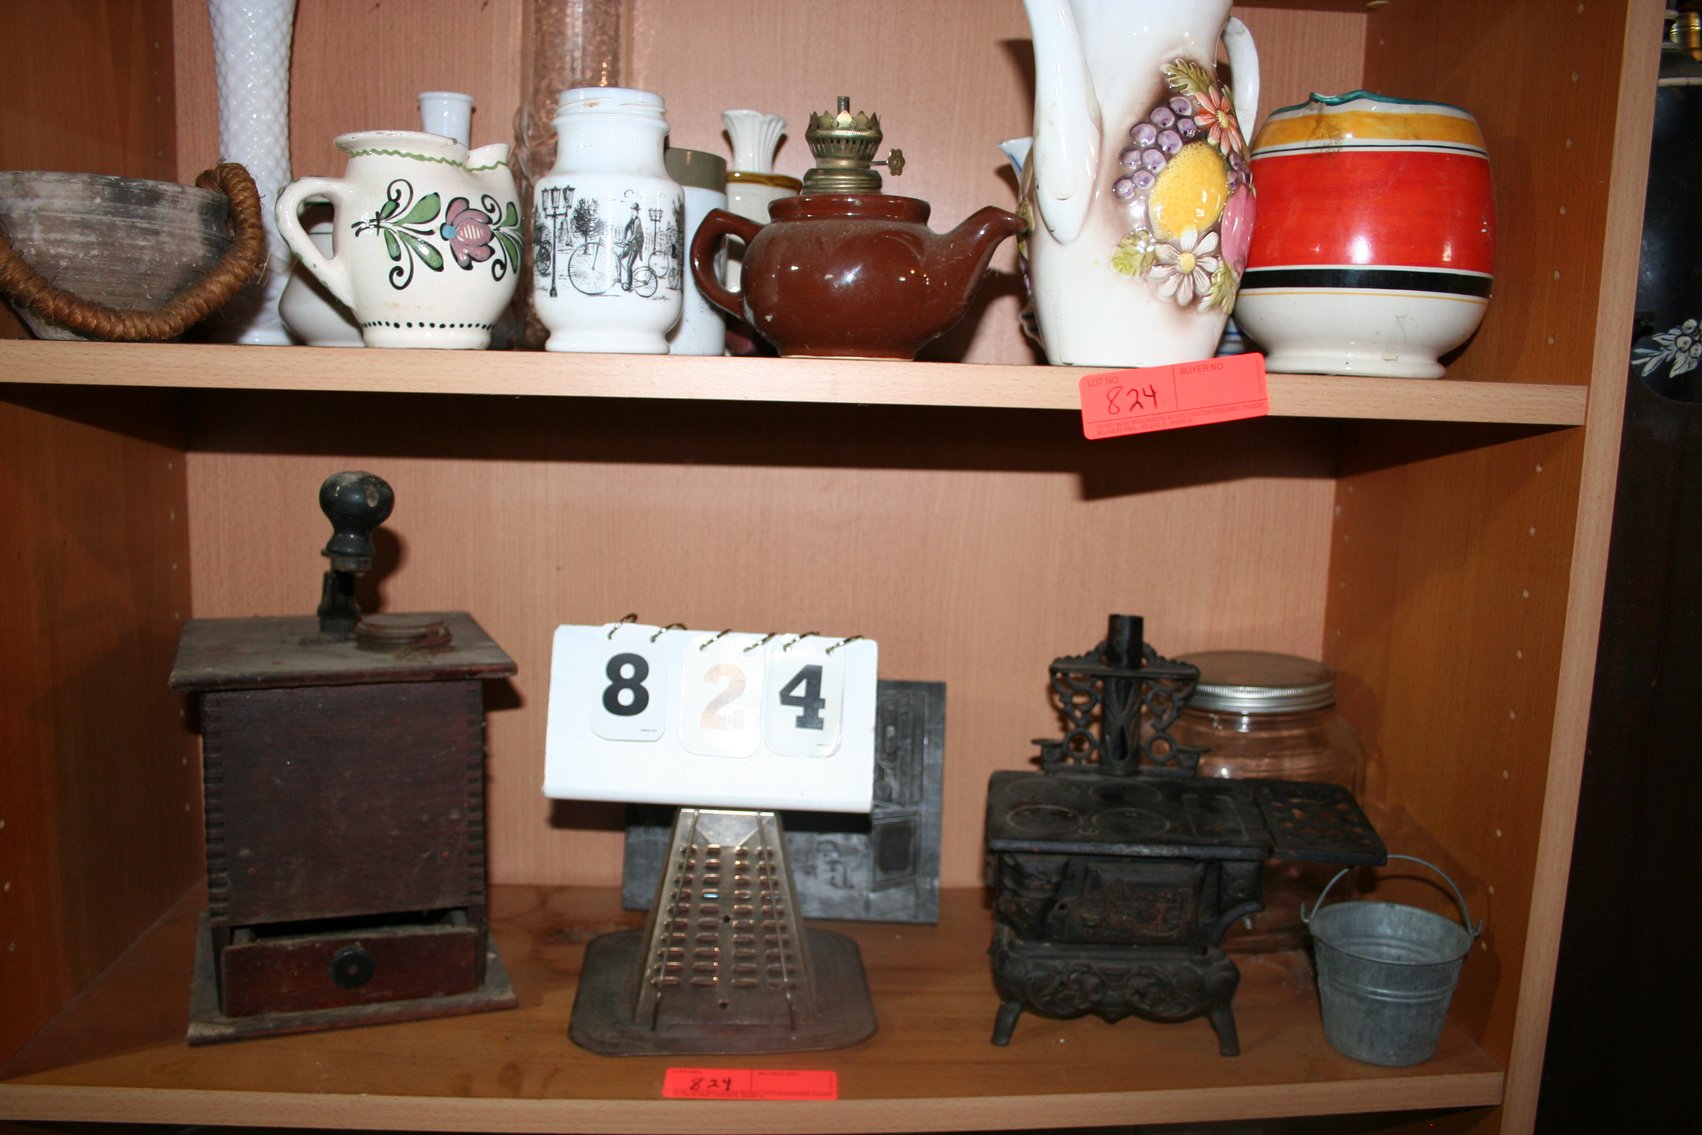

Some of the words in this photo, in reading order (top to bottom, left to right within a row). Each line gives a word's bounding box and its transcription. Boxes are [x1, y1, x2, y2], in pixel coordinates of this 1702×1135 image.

[1179, 363, 1208, 375] BUYER
[1087, 378, 1104, 387] LOT
[1106, 384, 1157, 415] 824
[690, 1077, 732, 1092] 824
